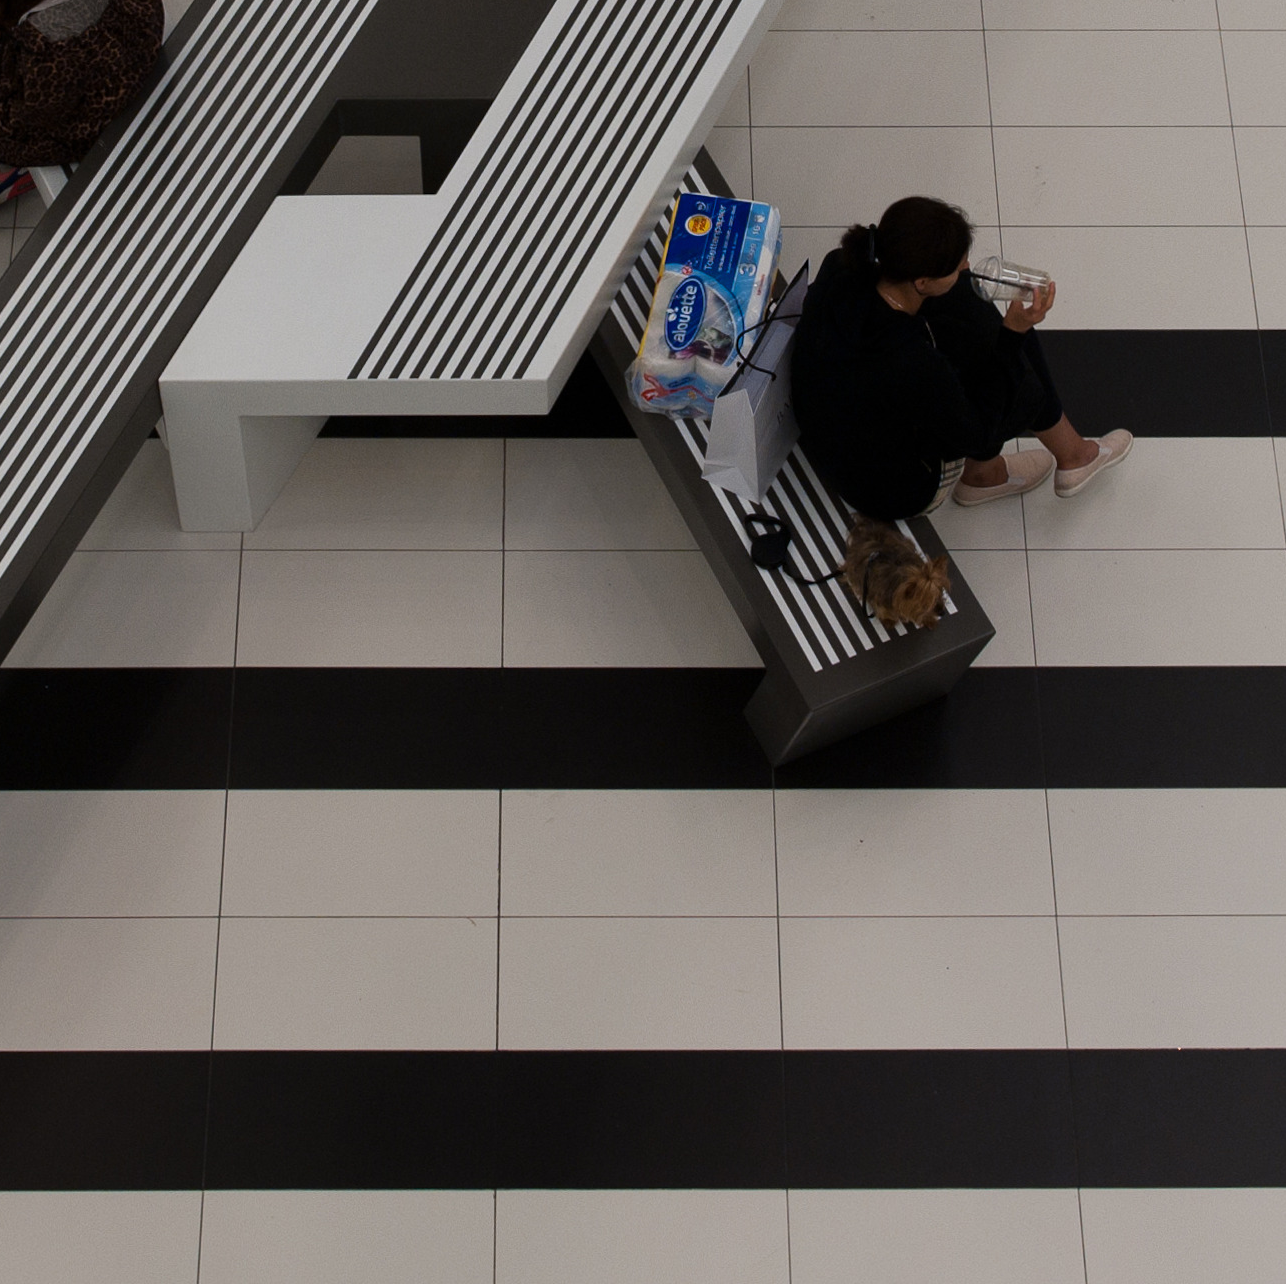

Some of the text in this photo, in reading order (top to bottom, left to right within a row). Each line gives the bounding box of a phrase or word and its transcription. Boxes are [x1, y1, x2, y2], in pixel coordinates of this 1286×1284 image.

[704, 204, 726, 270] Toilettenpapier
[739, 263, 757, 276] 3
[672, 285, 697, 343] alouette
